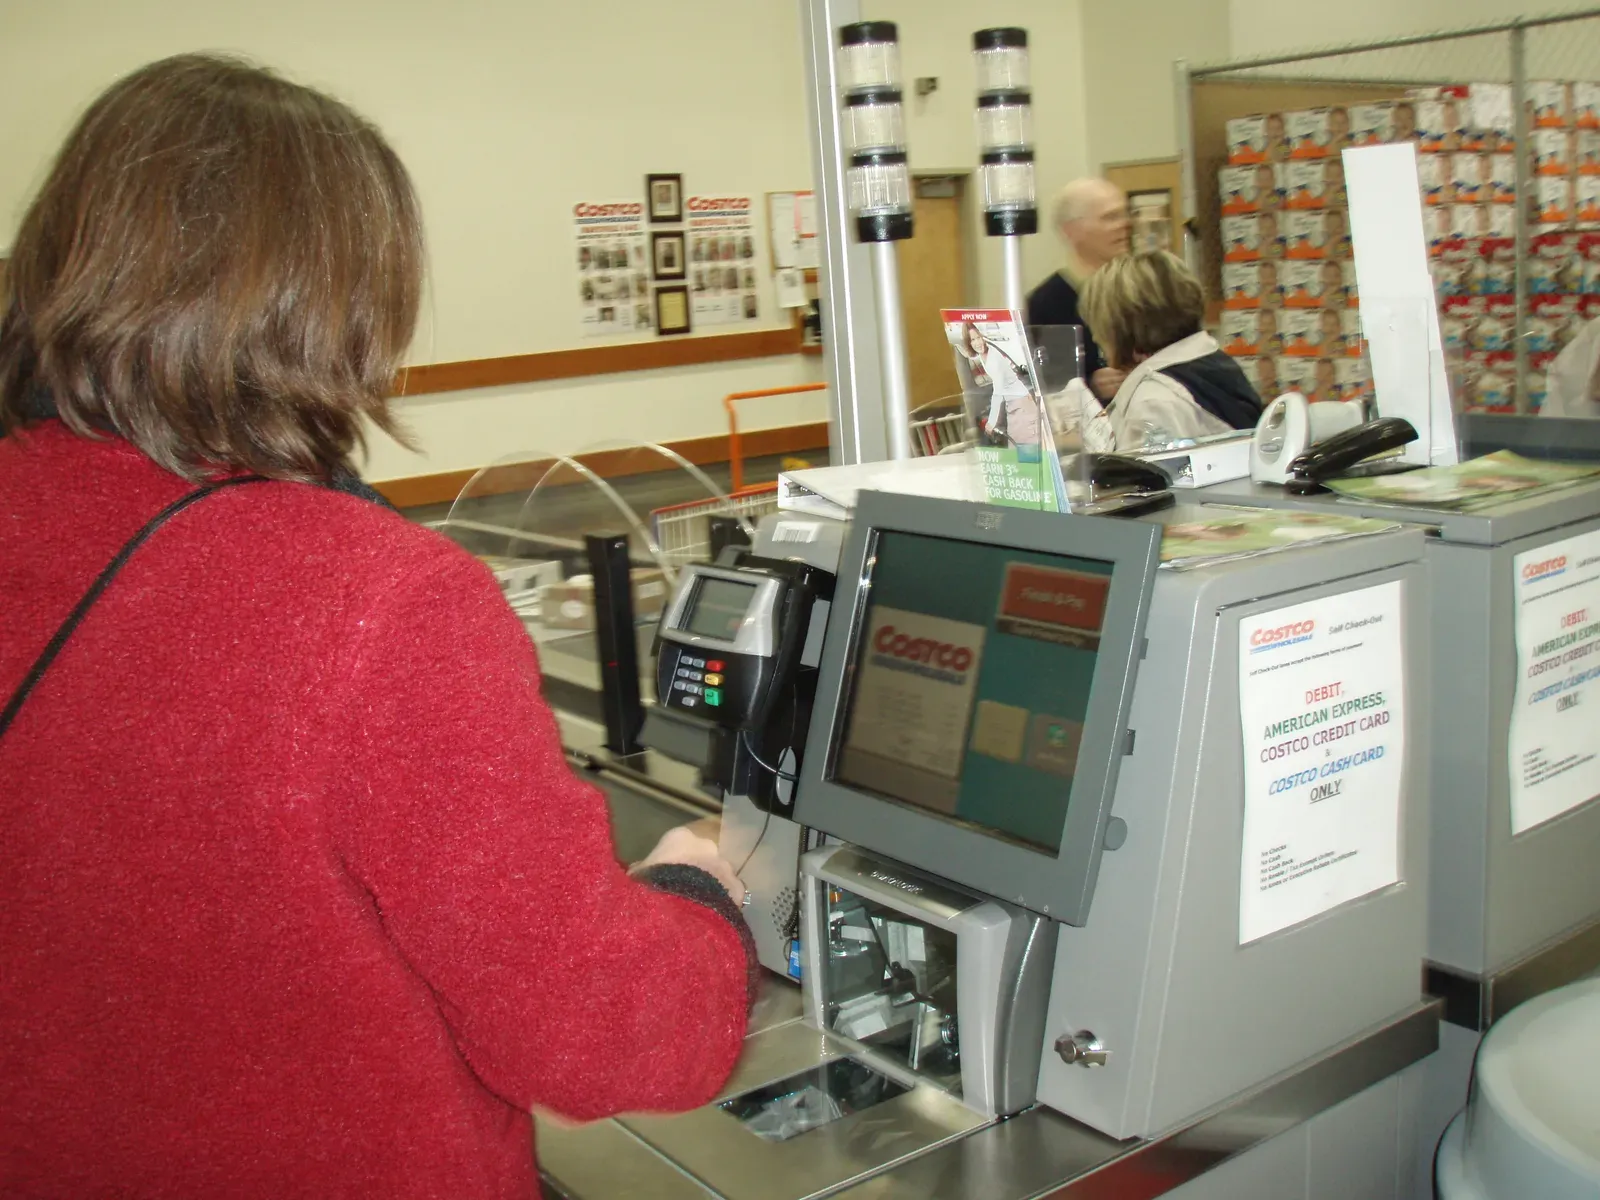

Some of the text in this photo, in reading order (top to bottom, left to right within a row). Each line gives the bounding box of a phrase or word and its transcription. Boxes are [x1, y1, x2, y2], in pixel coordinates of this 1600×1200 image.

[978, 451, 998, 463] NOW
[981, 463, 1019, 476] EARN 3%
[983, 475, 1033, 490] CASH BACK
[985, 487, 1001, 499] FOR
[1522, 555, 1566, 578] COSTCO
[1250, 620, 1315, 646] COSTCO
[1532, 630, 1576, 658] AMERICAN
[874, 625, 974, 672] COSTCO
[1528, 656, 1561, 679] COSTCO
[1305, 681, 1345, 705] DEBIT,
[1263, 691, 1386, 740] AMERICAN EXPRESS,
[1260, 711, 1390, 763] COSTCO CREDIT CARD
[1268, 745, 1384, 796] COSTCO CASH CARD
[1310, 779, 1342, 802] ONLY
